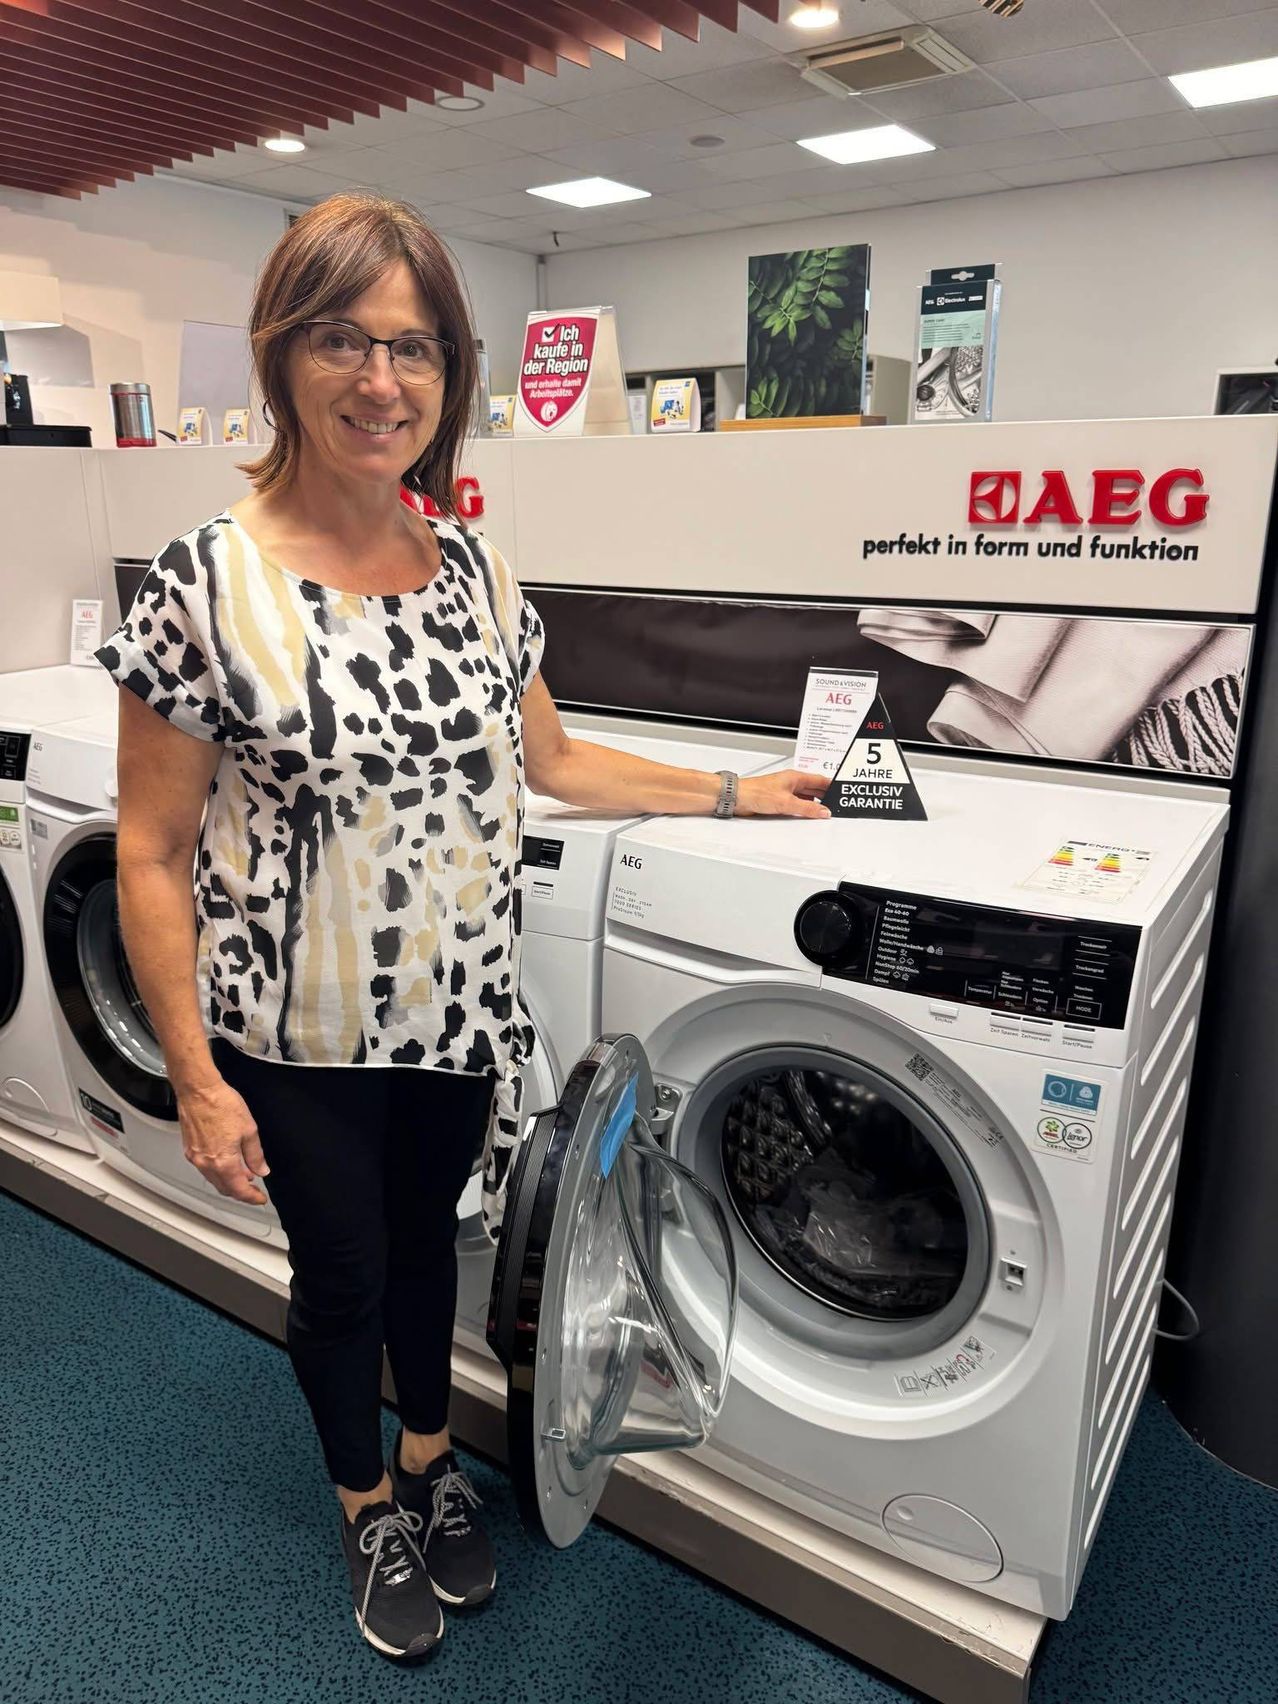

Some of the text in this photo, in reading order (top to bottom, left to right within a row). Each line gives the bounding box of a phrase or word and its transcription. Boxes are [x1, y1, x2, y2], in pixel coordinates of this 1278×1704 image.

[560, 324, 579, 341] Ich
[534, 341, 583, 358] kaufe in
[524, 358, 588, 376] der Region
[525, 377, 581, 389] und erhalte damit
[1023, 468, 1210, 526] AEG
[863, 533, 1198, 561] perfekt in form und funktion
[826, 692, 852, 705] AEG
[867, 721, 884, 729] AEG
[867, 743, 881, 765] 5
[853, 768, 893, 779] JAHRE
[841, 784, 903, 797] EXCLUSIV
[840, 797, 903, 810] GARANTIE
[620, 854, 642, 870] AEG
[886, 900, 917, 910] Programme
[1046, 1143, 1077, 1153] CERTIFIED
